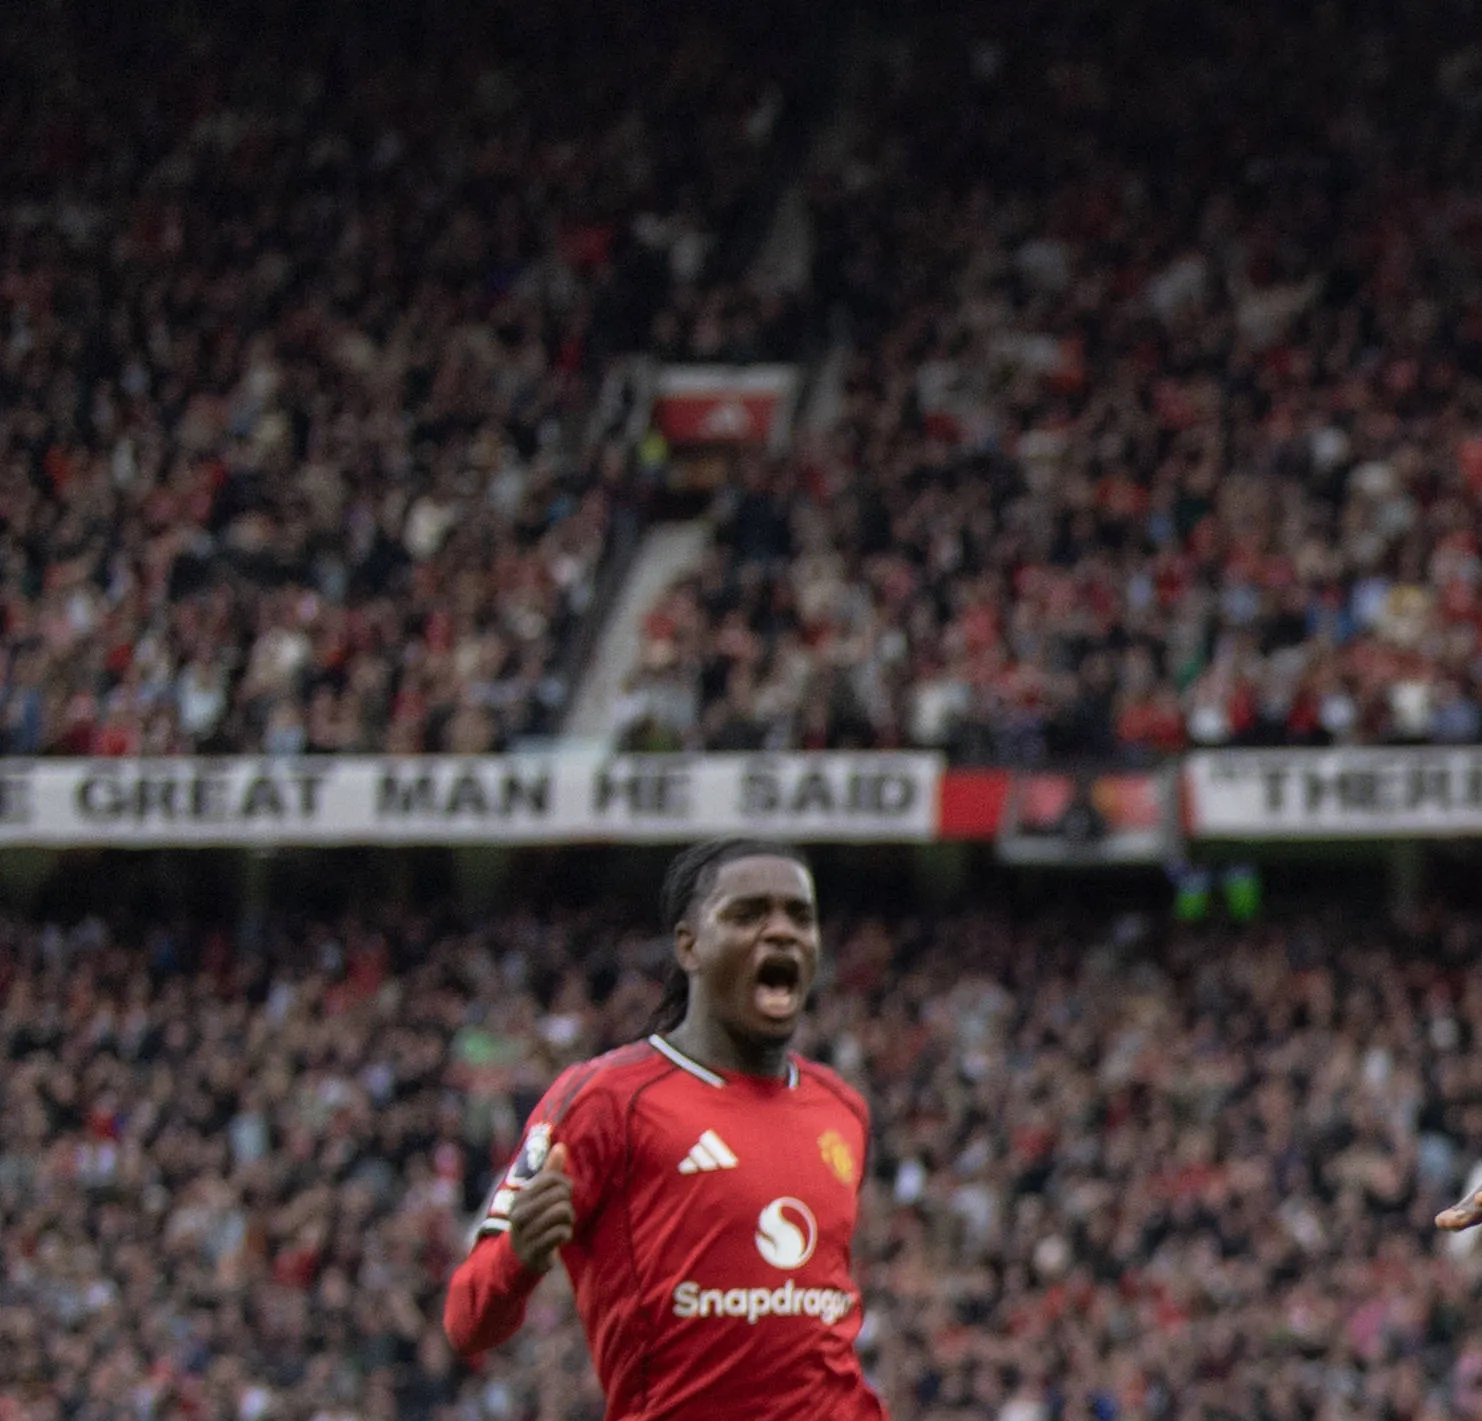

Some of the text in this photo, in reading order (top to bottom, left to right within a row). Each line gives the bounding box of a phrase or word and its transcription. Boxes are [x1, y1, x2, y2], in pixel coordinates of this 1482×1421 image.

[74, 768, 328, 821] GREAT
[375, 765, 552, 818] MAN
[591, 763, 690, 817] HE
[740, 762, 918, 816] SAID
